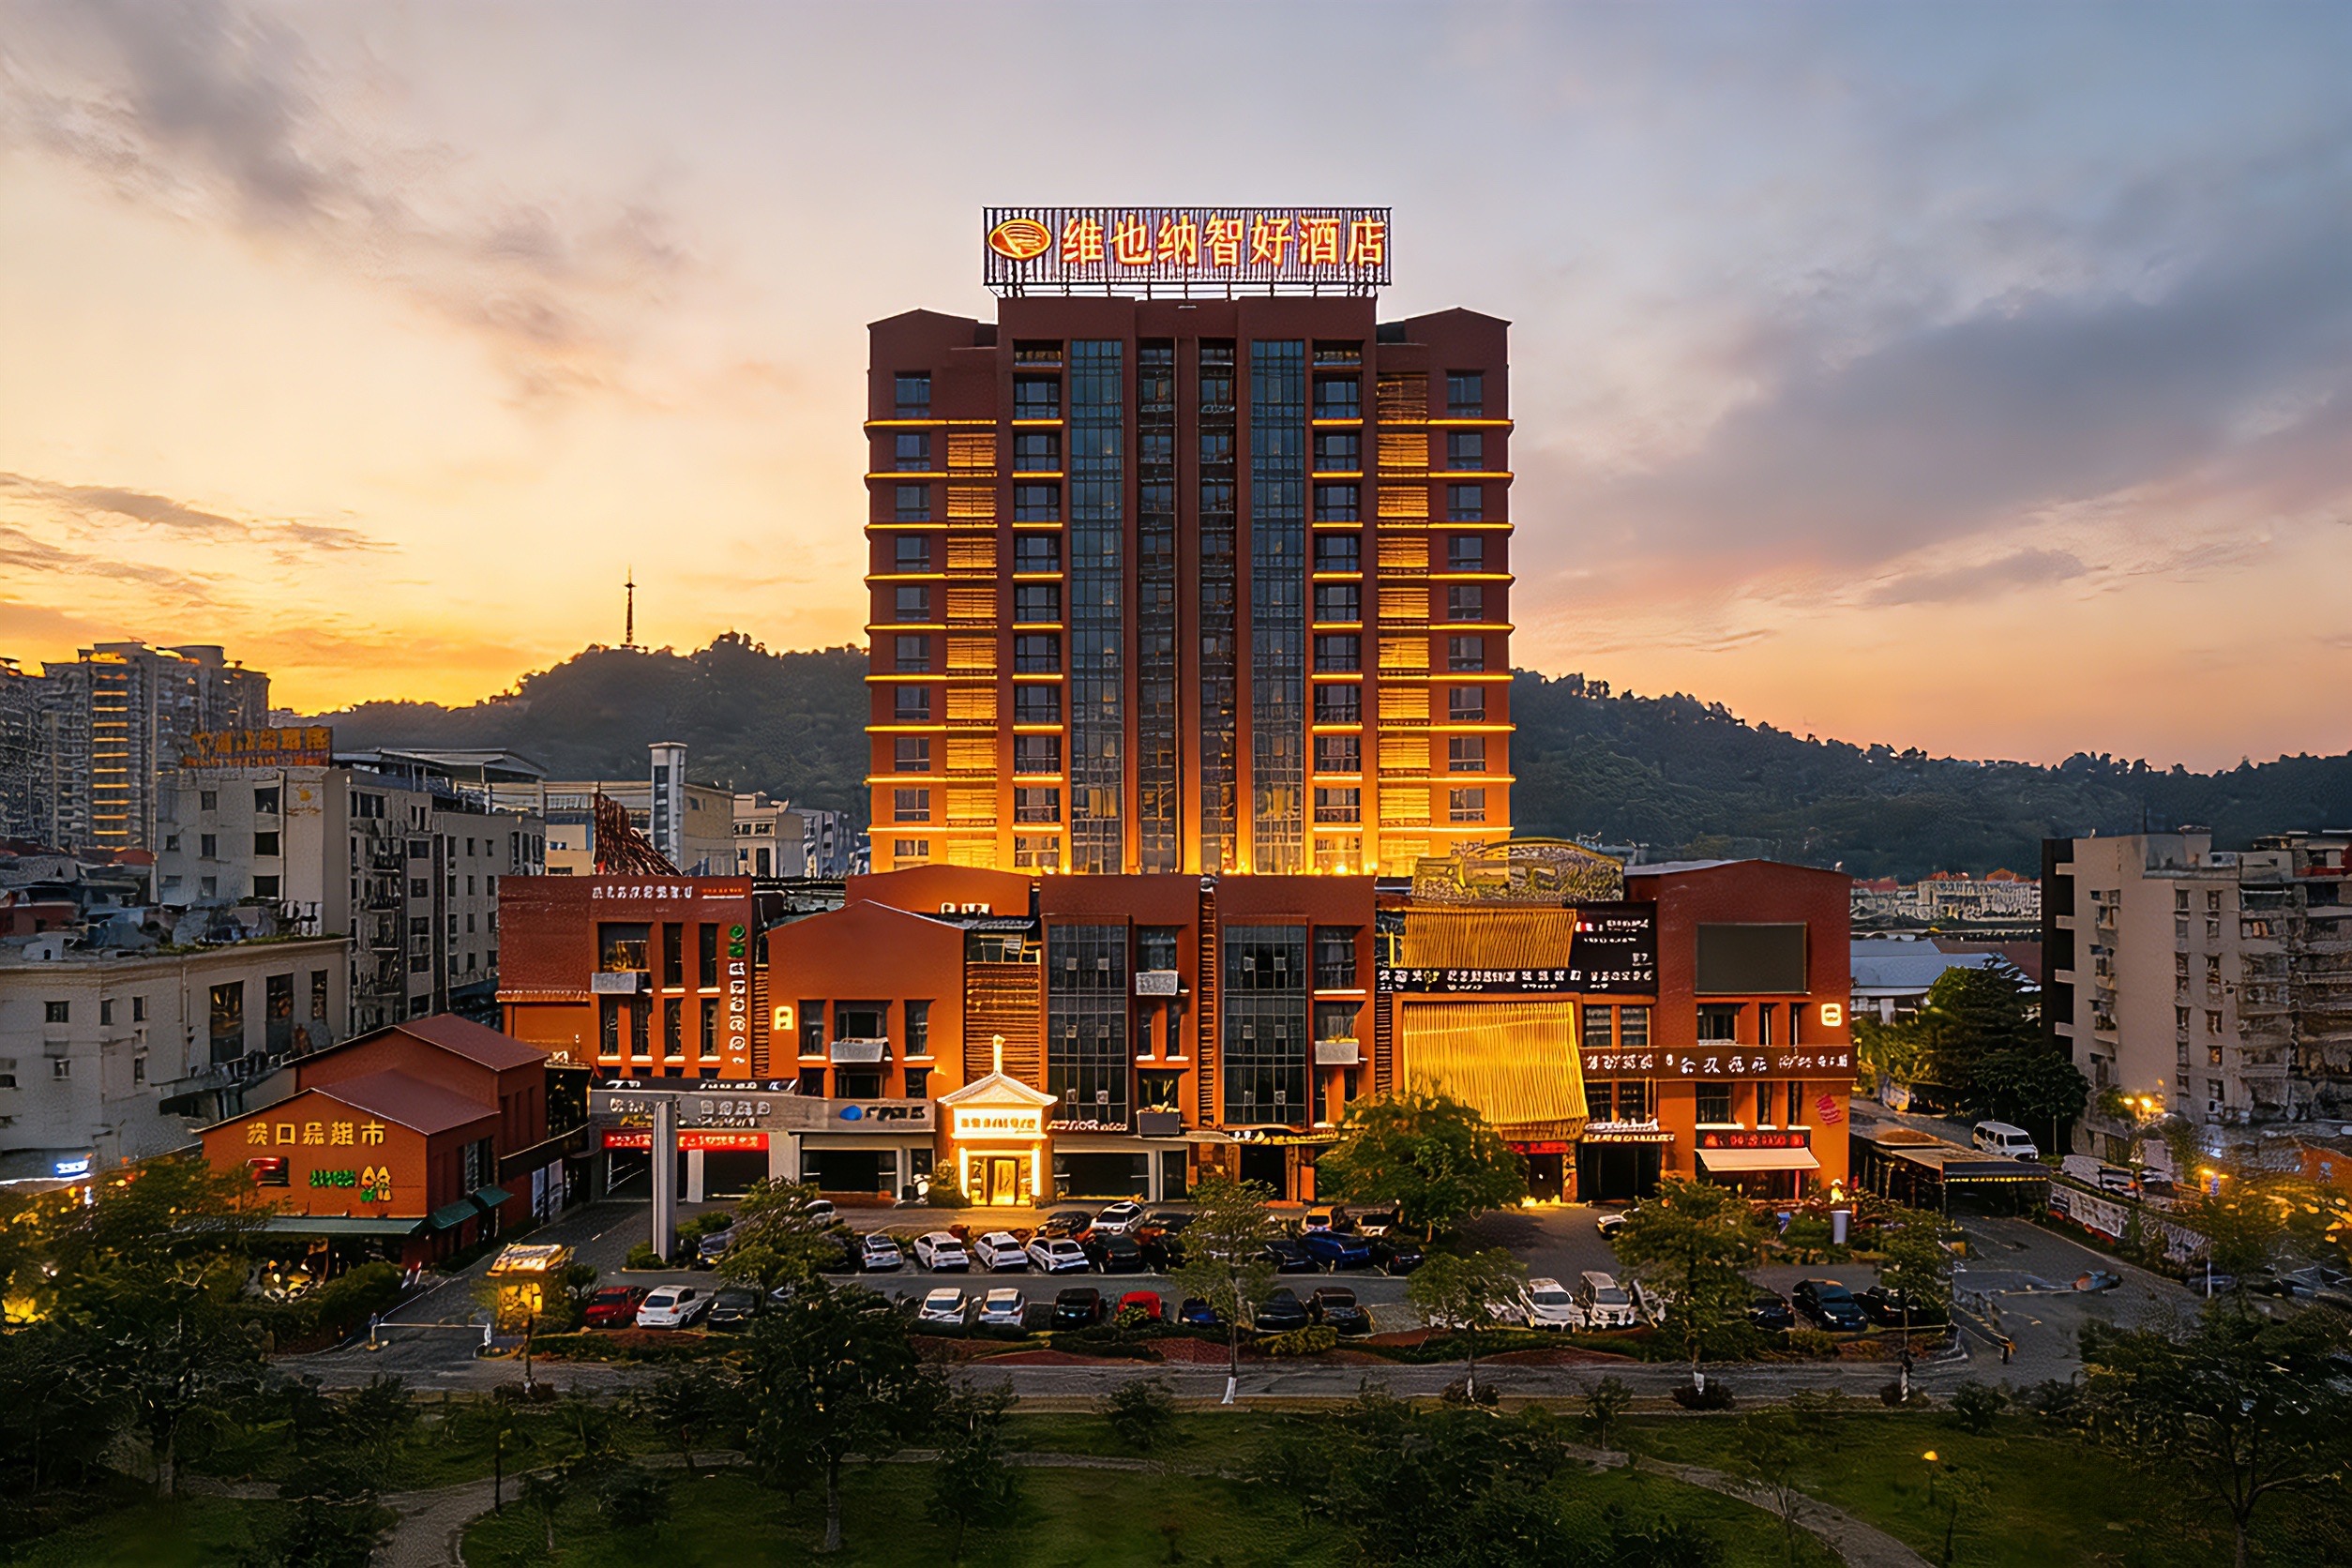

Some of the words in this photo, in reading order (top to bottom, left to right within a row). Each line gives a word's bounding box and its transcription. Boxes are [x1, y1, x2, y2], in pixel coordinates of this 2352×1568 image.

[1062, 214, 1386, 266] 维也纳智好酒店
